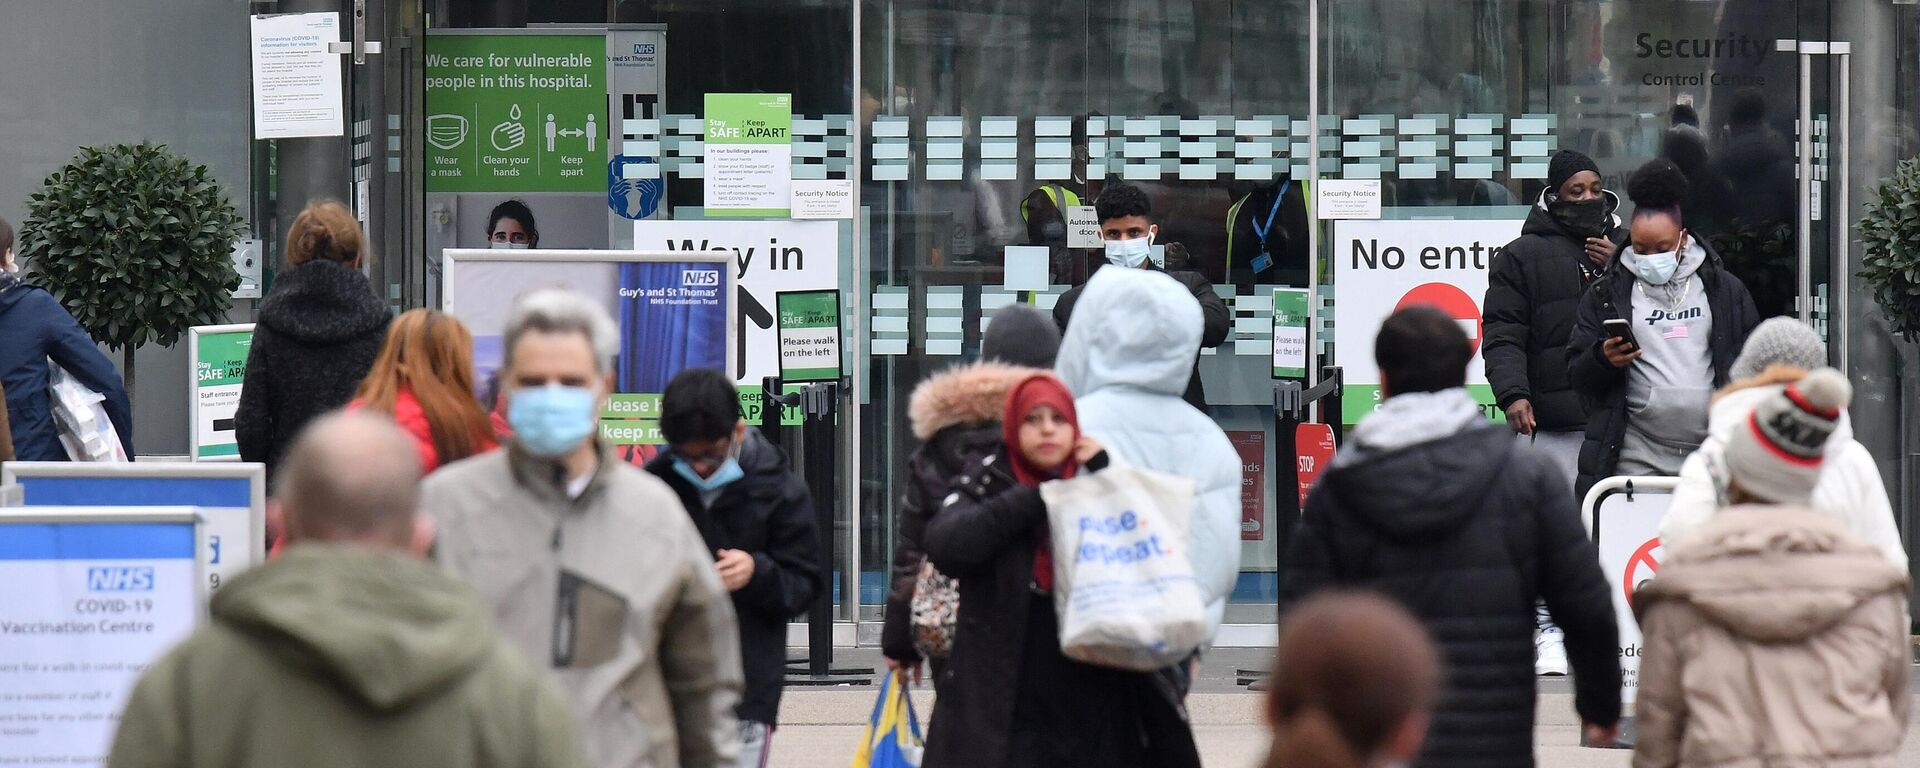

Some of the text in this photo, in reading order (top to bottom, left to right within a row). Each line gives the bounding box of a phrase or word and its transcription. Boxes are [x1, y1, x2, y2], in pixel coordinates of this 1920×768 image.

[634, 44, 654, 54] NHS
[1636, 32, 1771, 65] Security
[426, 54, 449, 68] We
[454, 56, 484, 68] care
[488, 53, 510, 68] for
[514, 54, 592, 68] vulnerable
[426, 74, 592, 91] people in this hospital.
[1642, 72, 1766, 86] Control Centre
[710, 120, 726, 128] Stay
[746, 120, 766, 128] Keep
[710, 128, 740, 138] SAFE
[746, 128, 786, 138] APART
[434, 156, 458, 164] Wear
[483, 156, 530, 167] Clean your
[561, 156, 583, 166] Keep
[438, 168, 462, 176] mask
[494, 168, 520, 176] hands
[560, 168, 584, 178] apart
[795, 190, 824, 198] Security
[1322, 190, 1351, 198] Security
[770, 238, 804, 270] in
[1352, 239, 1500, 270] No entr
[684, 272, 718, 284] NHS
[619, 288, 718, 298] Guy's and St Thomas'
[782, 316, 804, 324] SAFE
[783, 336, 835, 345] Please walk
[198, 362, 211, 370] Stay
[199, 369, 222, 380] SAFE
[605, 398, 649, 412] lease
[604, 425, 643, 441] keep
[1299, 456, 1314, 472] STOP
[90, 568, 154, 590] NHS
[75, 599, 153, 613] COVID-19
[1, 620, 155, 634] Vaccination Centre
[1622, 668, 1636, 676] he
